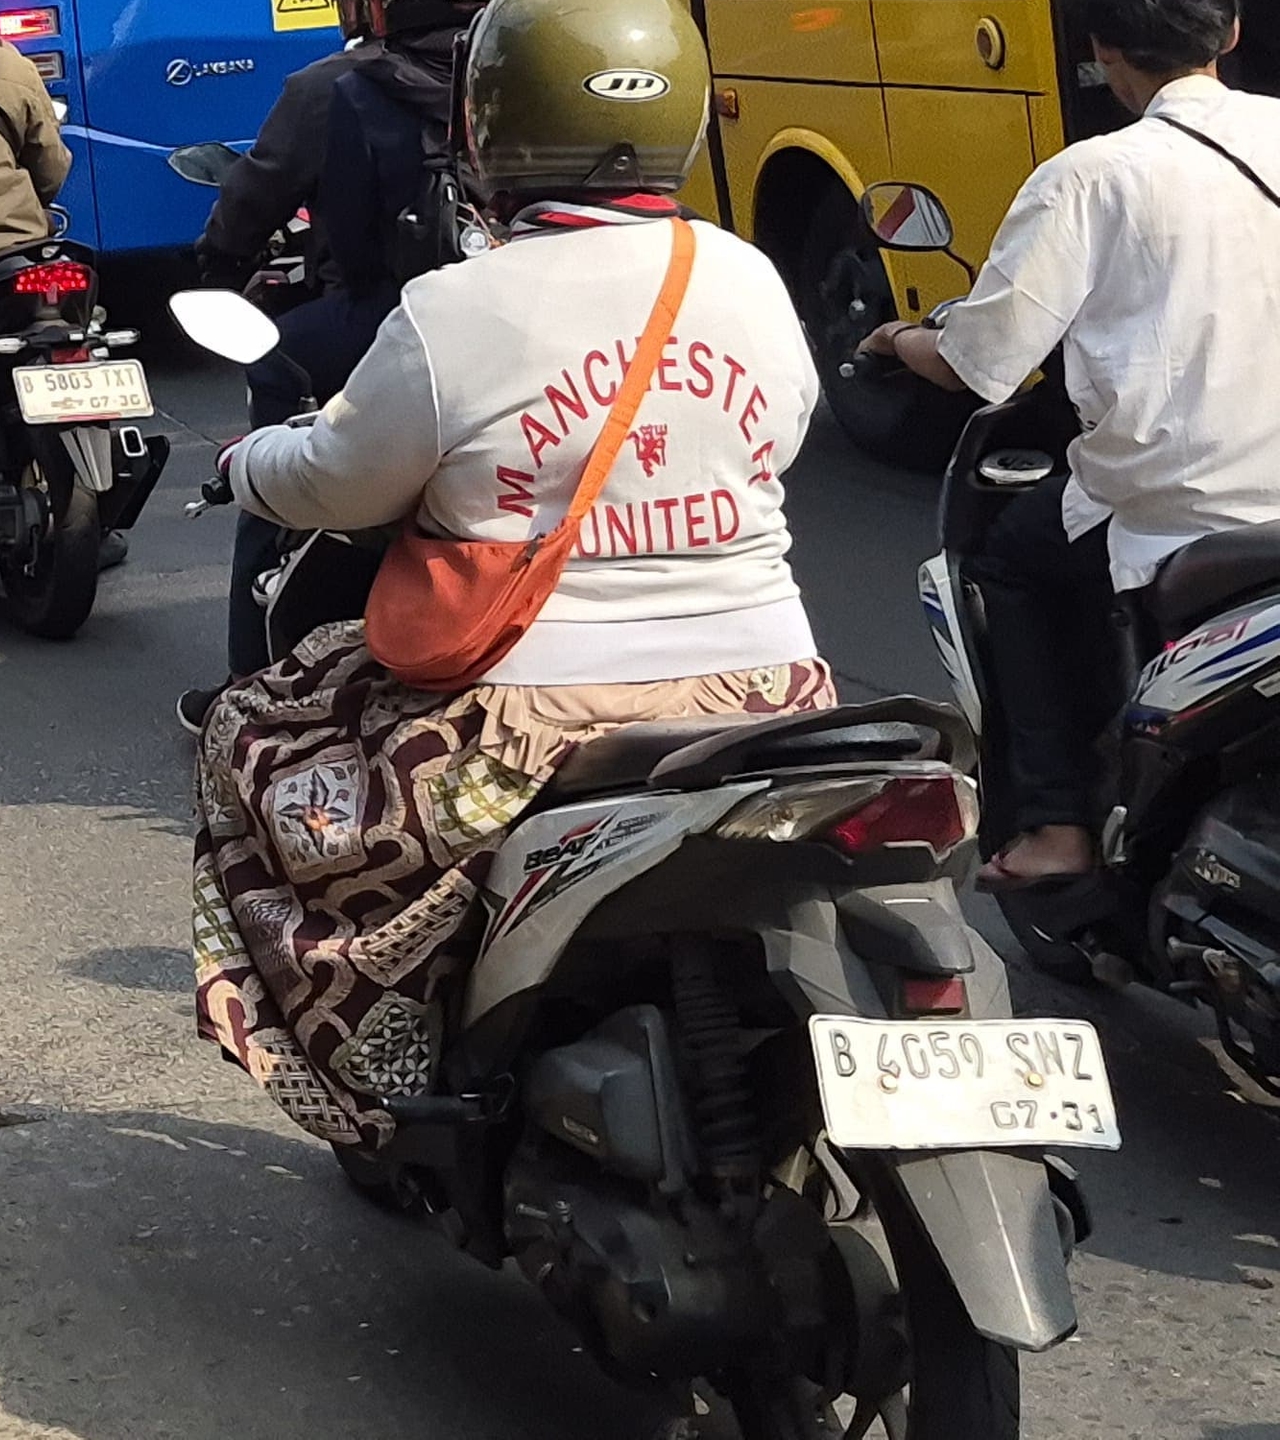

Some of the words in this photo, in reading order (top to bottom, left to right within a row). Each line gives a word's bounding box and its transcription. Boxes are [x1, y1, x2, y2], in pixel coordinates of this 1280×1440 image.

[602, 77, 656, 93] JP
[576, 489, 740, 558] UNITED
[829, 1028, 857, 1077] B
